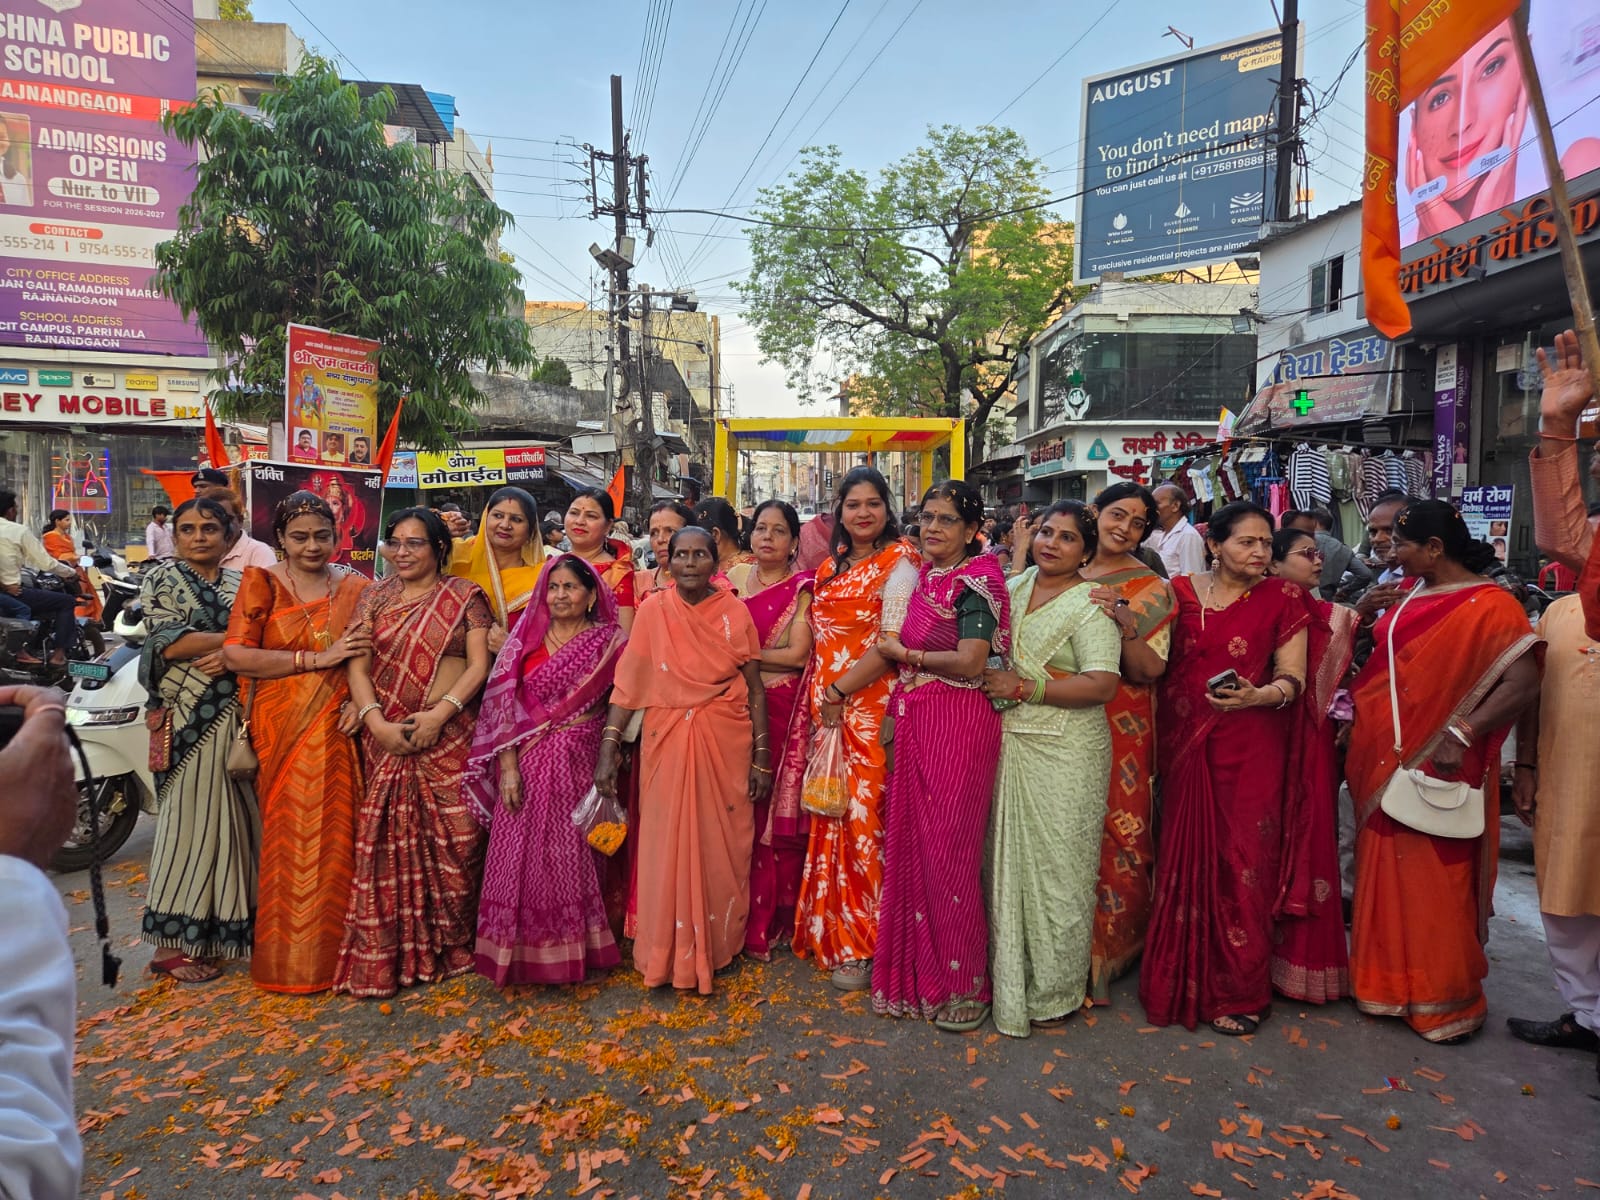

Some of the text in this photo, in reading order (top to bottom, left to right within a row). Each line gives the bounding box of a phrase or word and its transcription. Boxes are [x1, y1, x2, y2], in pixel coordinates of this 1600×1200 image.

[73, 23, 170, 62] PUBLIC
[4, 44, 115, 85] SCHOOL
[1091, 67, 1176, 104] AUGUST
[1, 81, 132, 115] AJNANDGAON
[37, 127, 167, 163] ADMISSIONS
[1098, 112, 1275, 162] You don't need maps
[69, 154, 138, 183] OPEN
[1106, 165, 1123, 180] to
[1126, 154, 1158, 175] find
[1161, 149, 1199, 171] your
[61, 179, 147, 203] Nur. to VII
[1096, 187, 1113, 197] You
[1112, 184, 1130, 193] can
[1129, 179, 1147, 193] just
[1147, 175, 1165, 186] call
[1165, 173, 1178, 183] us
[1178, 170, 1188, 180] at
[43, 200, 166, 219] FOR THE SESSION 2026-2027
[43, 227, 89, 238] CONTACT
[1091, 263, 1097, 271] 3
[1097, 259, 1132, 270] exclusive
[1132, 251, 1175, 265] residential
[1174, 245, 1208, 260] projects
[1207, 244, 1224, 254] are
[6, 268, 130, 286] CITY OFFICE ADDRESS
[22, 292, 118, 307] RAJNANDGAON
[58, 284, 124, 296] RAMADHIN
[19, 311, 124, 327] SCHOOL ADDRESS
[19, 323, 76, 335] CAMPUS,
[77, 327, 112, 337] PARRI
[113, 329, 146, 339] NALA
[25, 334, 120, 348] RAJNANDGAON
[294, 349, 375, 375] श्री राम नवमी
[167, 379, 199, 387] SAMSUNG
[0, 392, 200, 418] EY MOBILE NX
[1122, 432, 1167, 455] लक्ष्मी
[1433, 434, 1446, 474] News
[448, 456, 476, 467] ओम
[254, 466, 284, 481] शक्ति
[364, 477, 381, 489] नहीं
[422, 467, 503, 484] मोबाईल
[1463, 486, 1511, 503] चर्म रोग
[350, 548, 375, 560] प्रदर्शन
